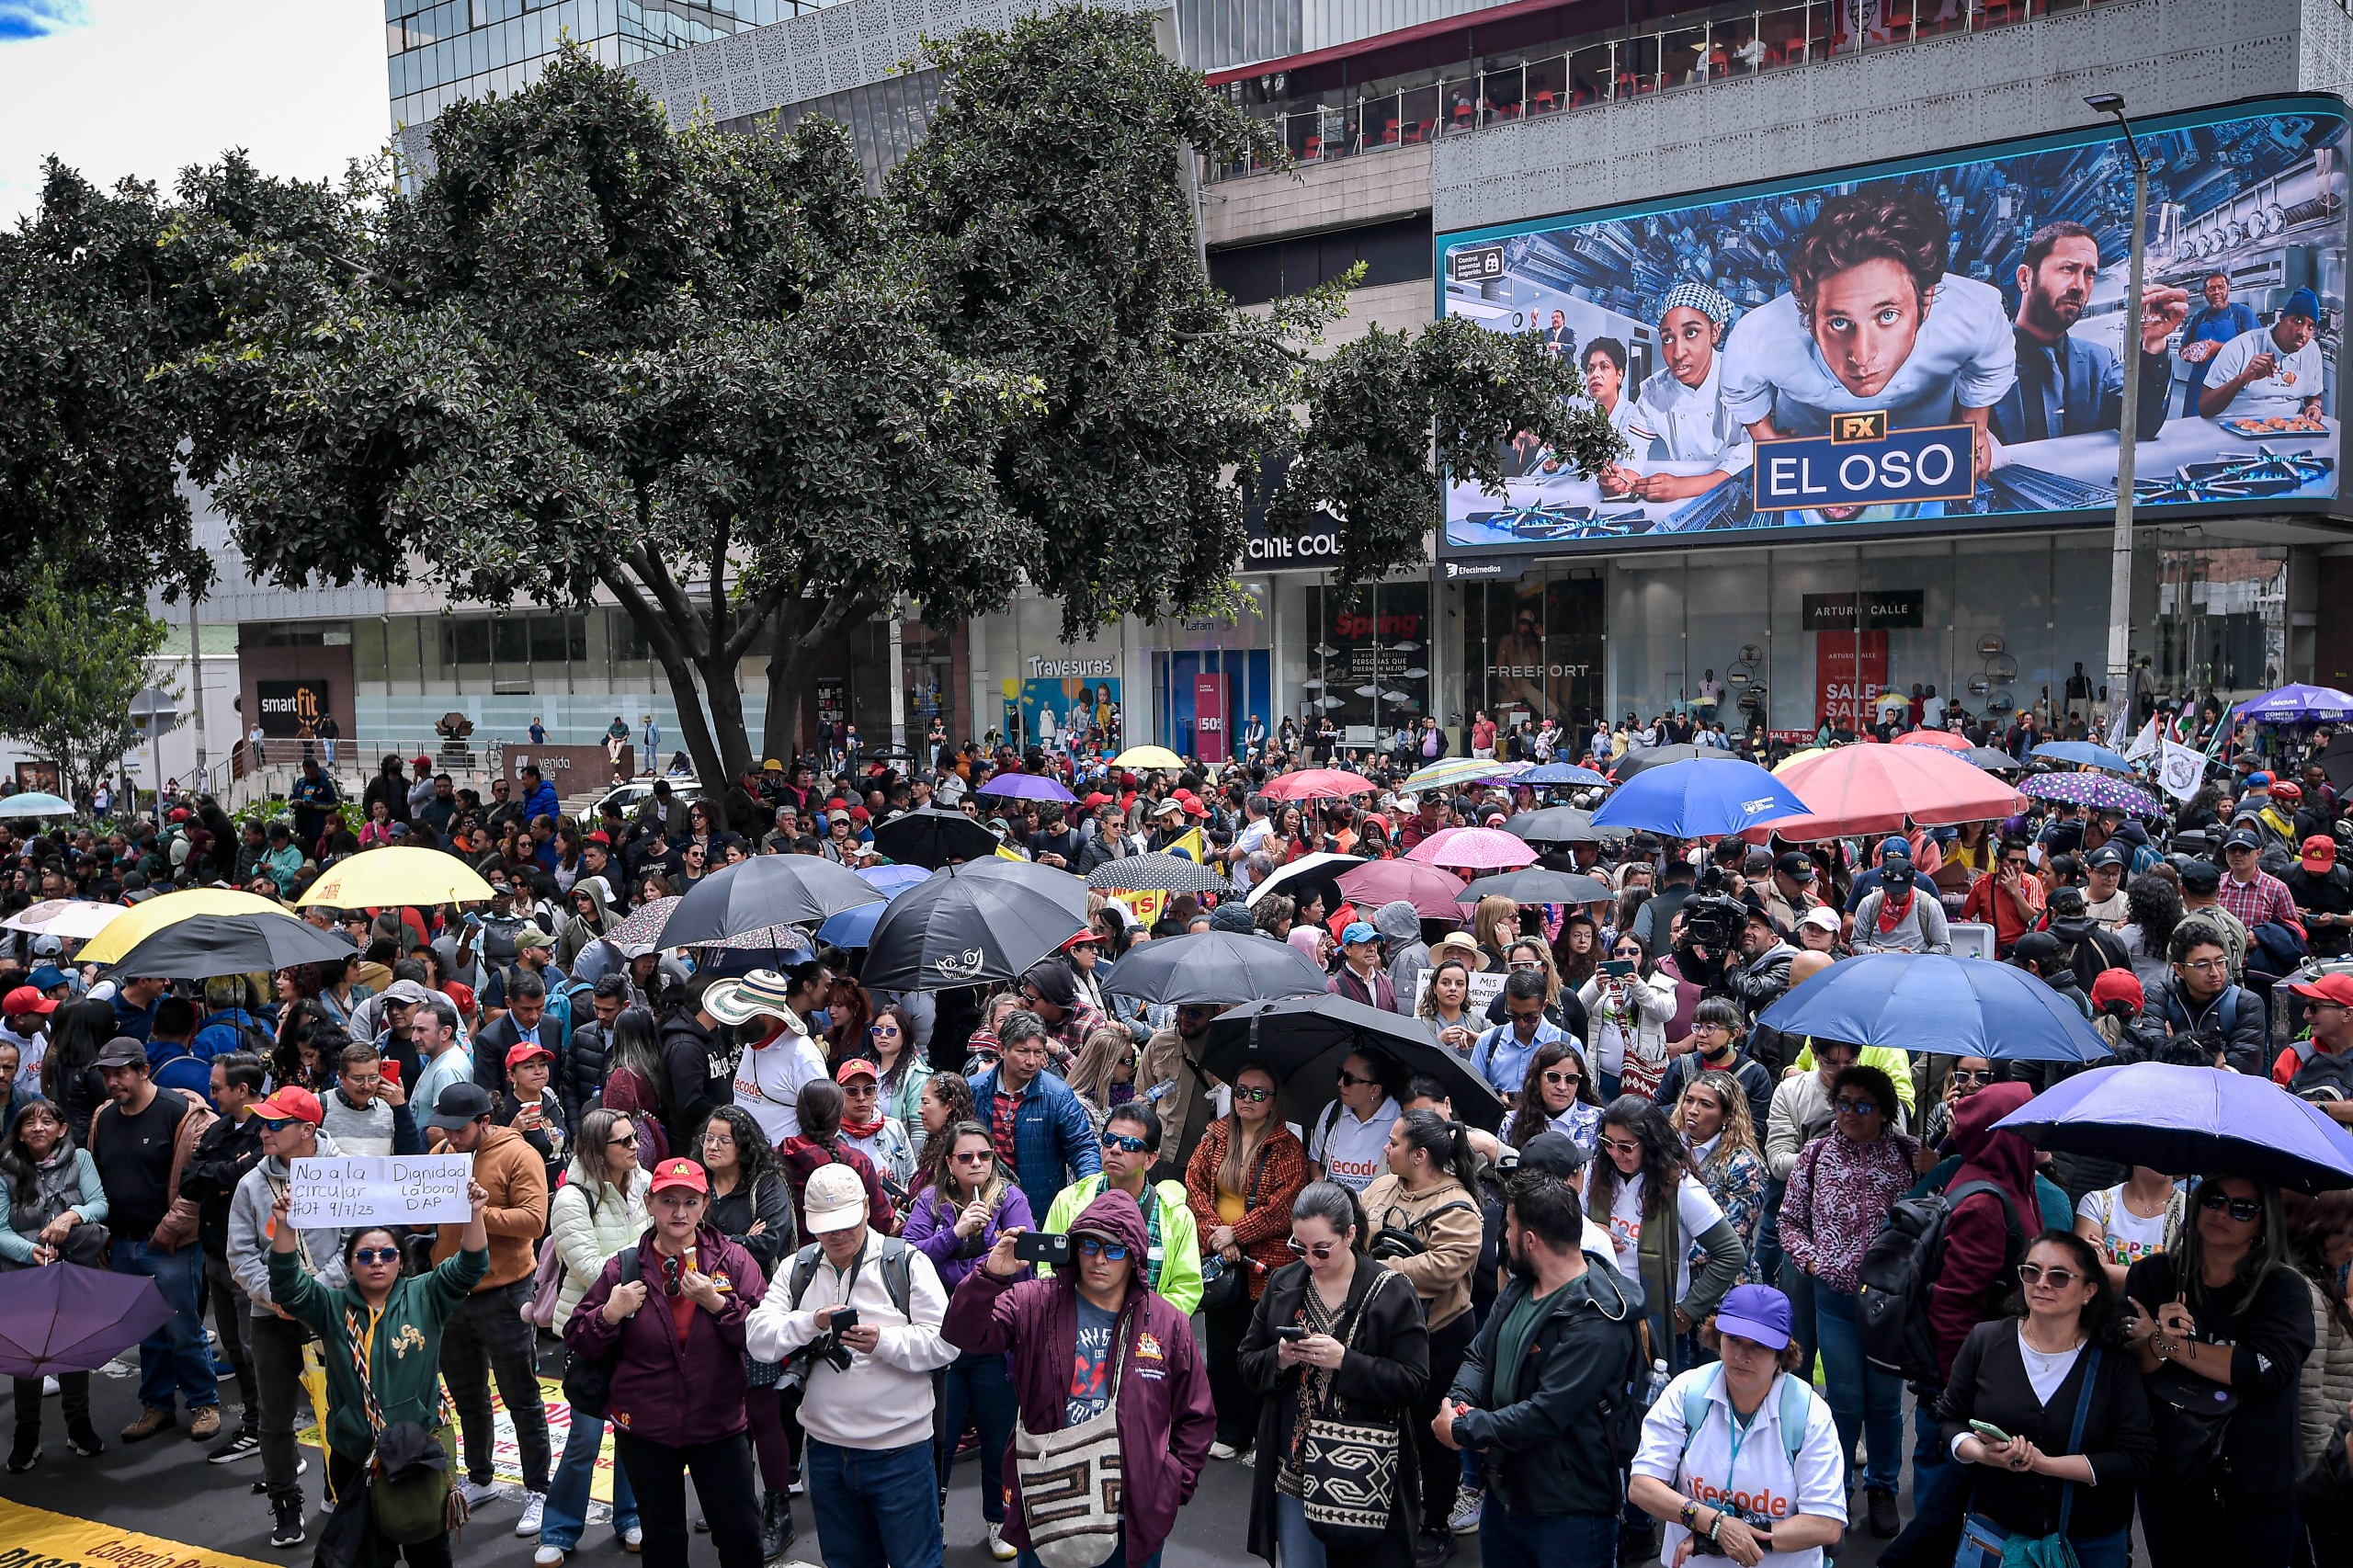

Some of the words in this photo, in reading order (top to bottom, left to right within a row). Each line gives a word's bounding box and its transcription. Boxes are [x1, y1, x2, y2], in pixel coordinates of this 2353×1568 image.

[1458, 256, 1478, 264] Control
[1458, 262, 1481, 271] parental
[1458, 269, 1482, 278] sugerido
[1843, 416, 1875, 438] FX
[1770, 458, 1827, 496] EL
[1838, 443, 1955, 492] OSO
[1459, 564, 1501, 575] Efectimedios
[1815, 606, 1862, 617] ARTURO
[1870, 604, 1908, 615] CALLE
[1187, 621, 1214, 631] Lafam
[1336, 609, 1418, 640] Spring
[1028, 654, 1113, 678] Travesuras
[1487, 665, 1589, 677] FREEPORT
[1825, 684, 1876, 699] SALE
[1824, 701, 1876, 717] SALE
[1479, 977, 1497, 988] MIS
[296, 1163, 322, 1180] No
[329, 1168, 339, 1180] a
[347, 1161, 366, 1180] la
[393, 1161, 467, 1186] Dignidad
[295, 1178, 367, 1200] circular
[292, 1202, 320, 1218] #07
[329, 1201, 374, 1217] 9/7/25
